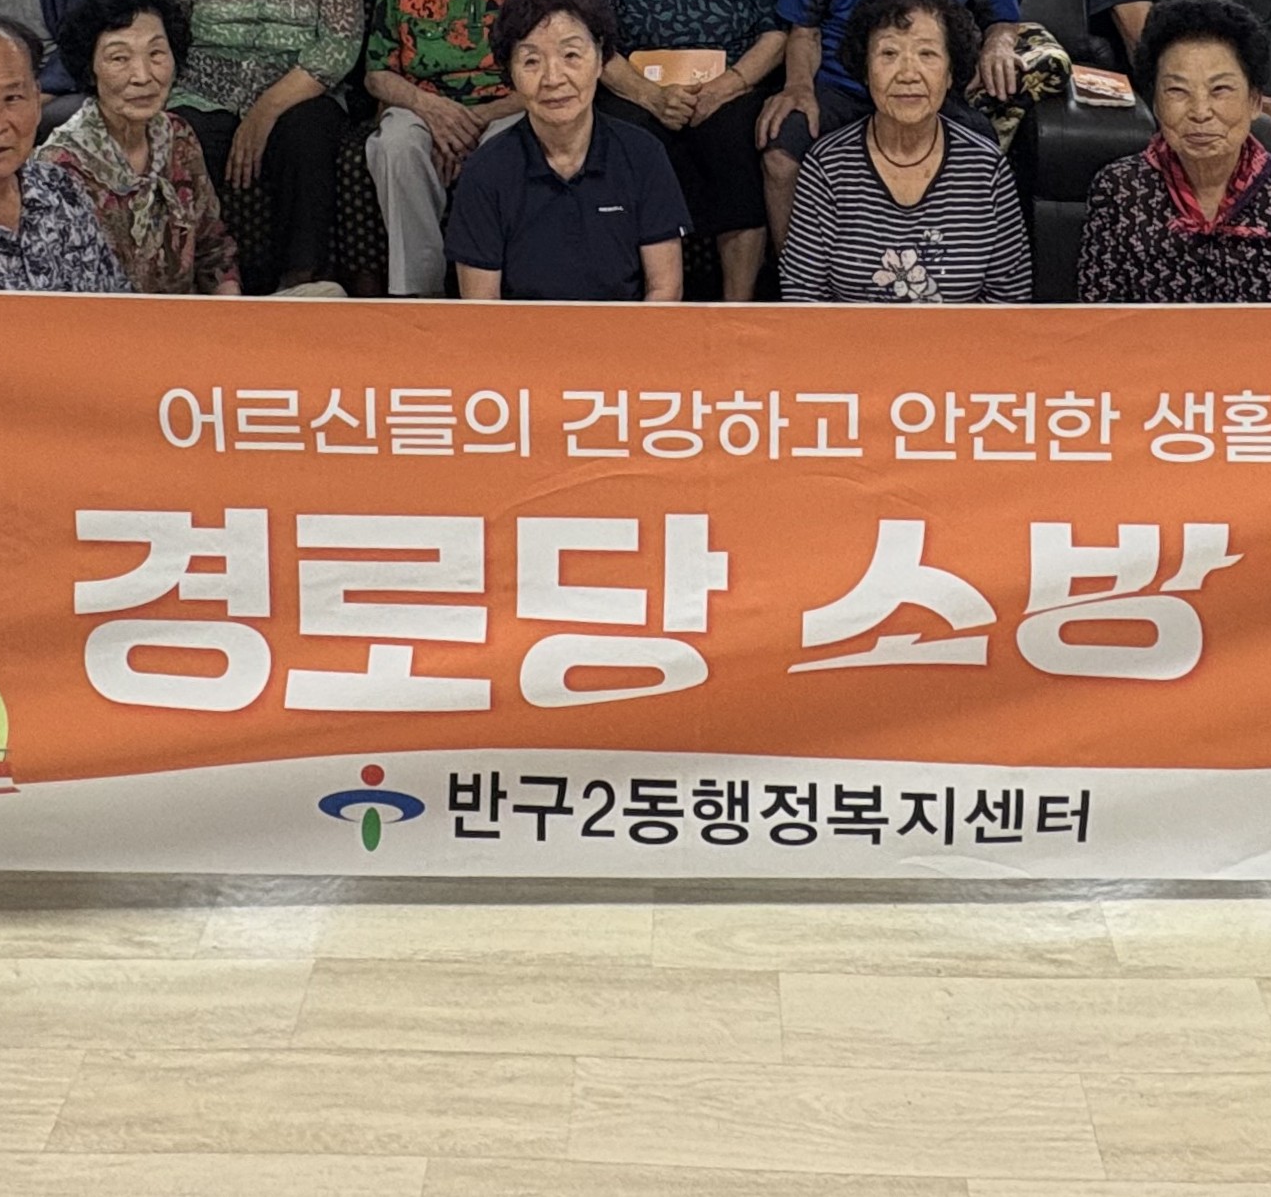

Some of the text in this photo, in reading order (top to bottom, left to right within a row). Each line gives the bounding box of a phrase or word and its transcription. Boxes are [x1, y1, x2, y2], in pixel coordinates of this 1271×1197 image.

[159, 385, 530, 458] 어르신들의
[562, 389, 863, 459] 건강하고
[890, 390, 1120, 461] 안전한
[74, 508, 728, 712] 경로당
[788, 519, 1244, 680] 소방
[447, 770, 1093, 846] 반구2동행정복지센터
